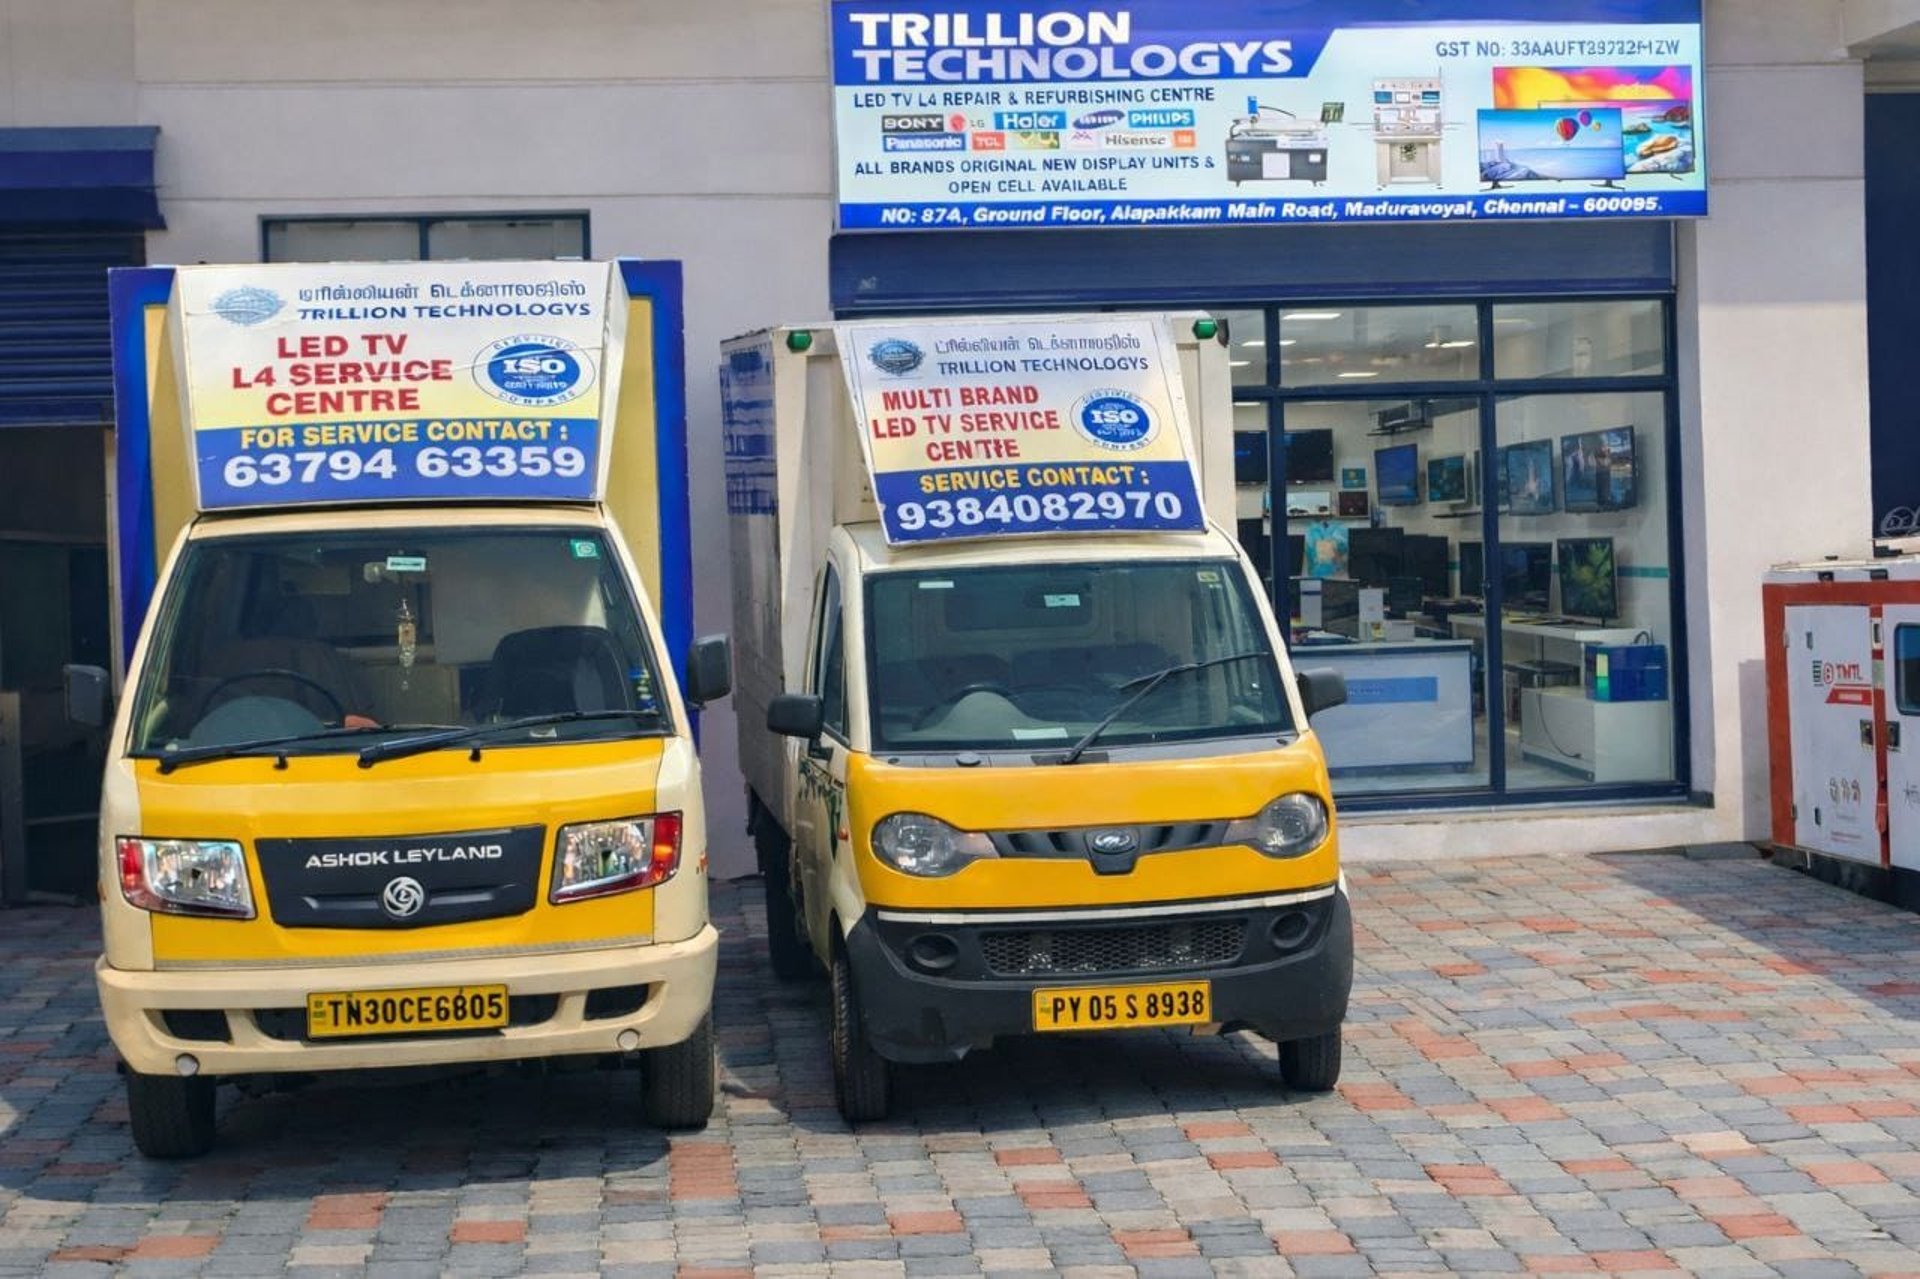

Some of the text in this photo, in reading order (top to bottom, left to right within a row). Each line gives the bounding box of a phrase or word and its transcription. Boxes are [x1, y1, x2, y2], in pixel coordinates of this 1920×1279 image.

[850, 12, 1130, 46] TRILLION
[852, 41, 1293, 81] TECHNOLOGYS
[1436, 42, 1470, 57] GST
[1477, 41, 1505, 57] NO:
[854, 87, 1215, 108] LED TV L4 REPAIR & REFURBISHING CENTRE
[883, 117, 942, 129] SONY
[970, 119, 985, 128] LG
[1130, 112, 1191, 125] PHILIPS
[886, 137, 962, 150] Panasonic
[975, 137, 1001, 147] TCL
[1105, 134, 1167, 146] Hisense
[855, 156, 1215, 175] ALL BRANDS ORIGINAL NEW DISPLAY UNITS &
[949, 178, 1128, 193] OPEN CELL AVAILABLE
[882, 208, 916, 224] NO:
[973, 207, 1045, 222] Ground
[1052, 206, 1105, 222] Floor,
[1112, 204, 1221, 222] Alapakkam
[1227, 203, 1274, 218] Main
[1282, 202, 1338, 220] Road,
[1345, 201, 1477, 219] Maduravoyal,
[1484, 199, 1566, 214] Chennai
[299, 303, 591, 320] TRILLION TECHNOLOGYS
[277, 334, 408, 360] LED TV
[232, 359, 453, 389] L4 SERVICE
[503, 359, 566, 375] ISO
[937, 357, 1149, 376] TRILLION TECHNOLOGYS
[266, 388, 420, 416] CENTRE
[882, 386, 1039, 411] MULTI BRAND
[872, 411, 1060, 439] LED TV SERVICE
[1091, 408, 1140, 424] ISO
[241, 426, 295, 450] FOR
[303, 422, 418, 447] SERVICE
[427, 420, 552, 442] CONTACT
[224, 446, 586, 488] 63794 63359
[920, 469, 1021, 494] SERVICE
[1027, 466, 1134, 489] CONTACT
[899, 491, 1183, 531] 9384082970
[305, 845, 503, 868] ASHOK LEYLAND
[328, 993, 503, 1027] TN30CE6805
[1053, 997, 1081, 1023] PY
[1090, 996, 1117, 1021] 05
[1126, 994, 1138, 1019] S
[1146, 990, 1204, 1018] 8938
